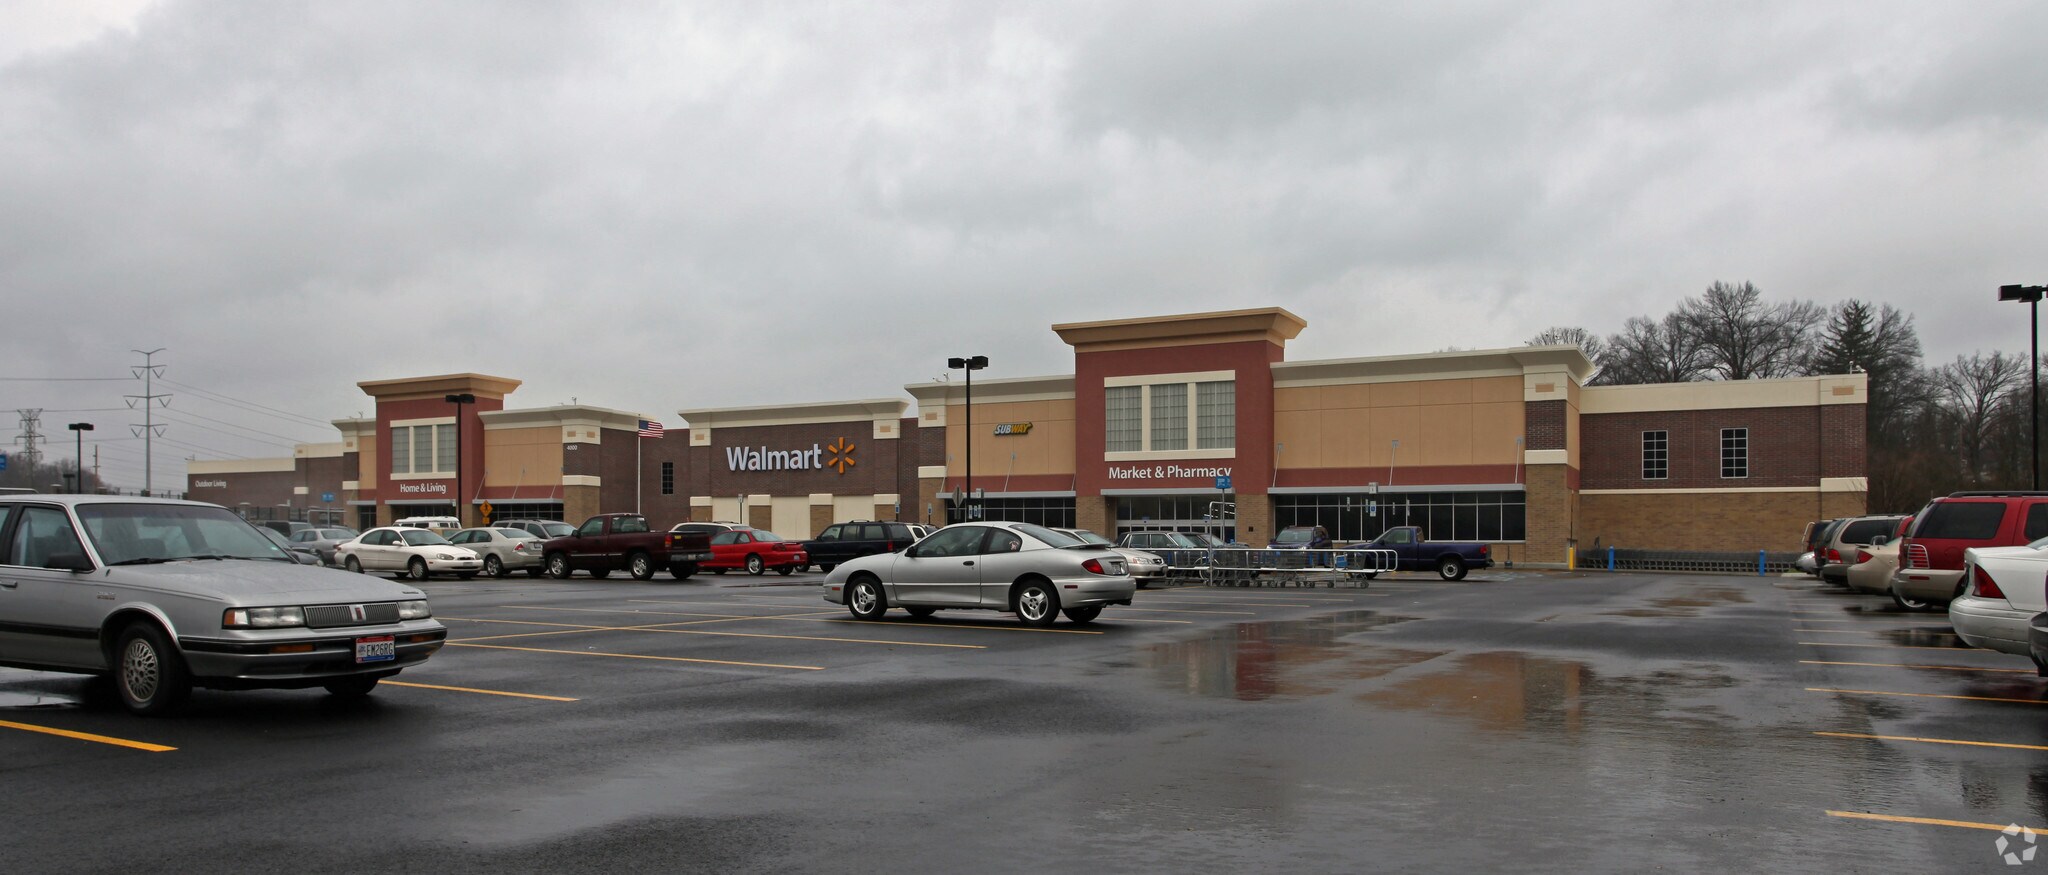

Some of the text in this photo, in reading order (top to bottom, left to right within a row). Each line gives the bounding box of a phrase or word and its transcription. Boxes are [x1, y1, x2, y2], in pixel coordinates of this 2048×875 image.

[995, 423, 1032, 435] SUBWAY
[726, 443, 822, 471] Walmart
[1108, 465, 1232, 479] Market & Pharmacy
[195, 480, 227, 489] Outdoor Living
[400, 482, 447, 495] Home & Living
